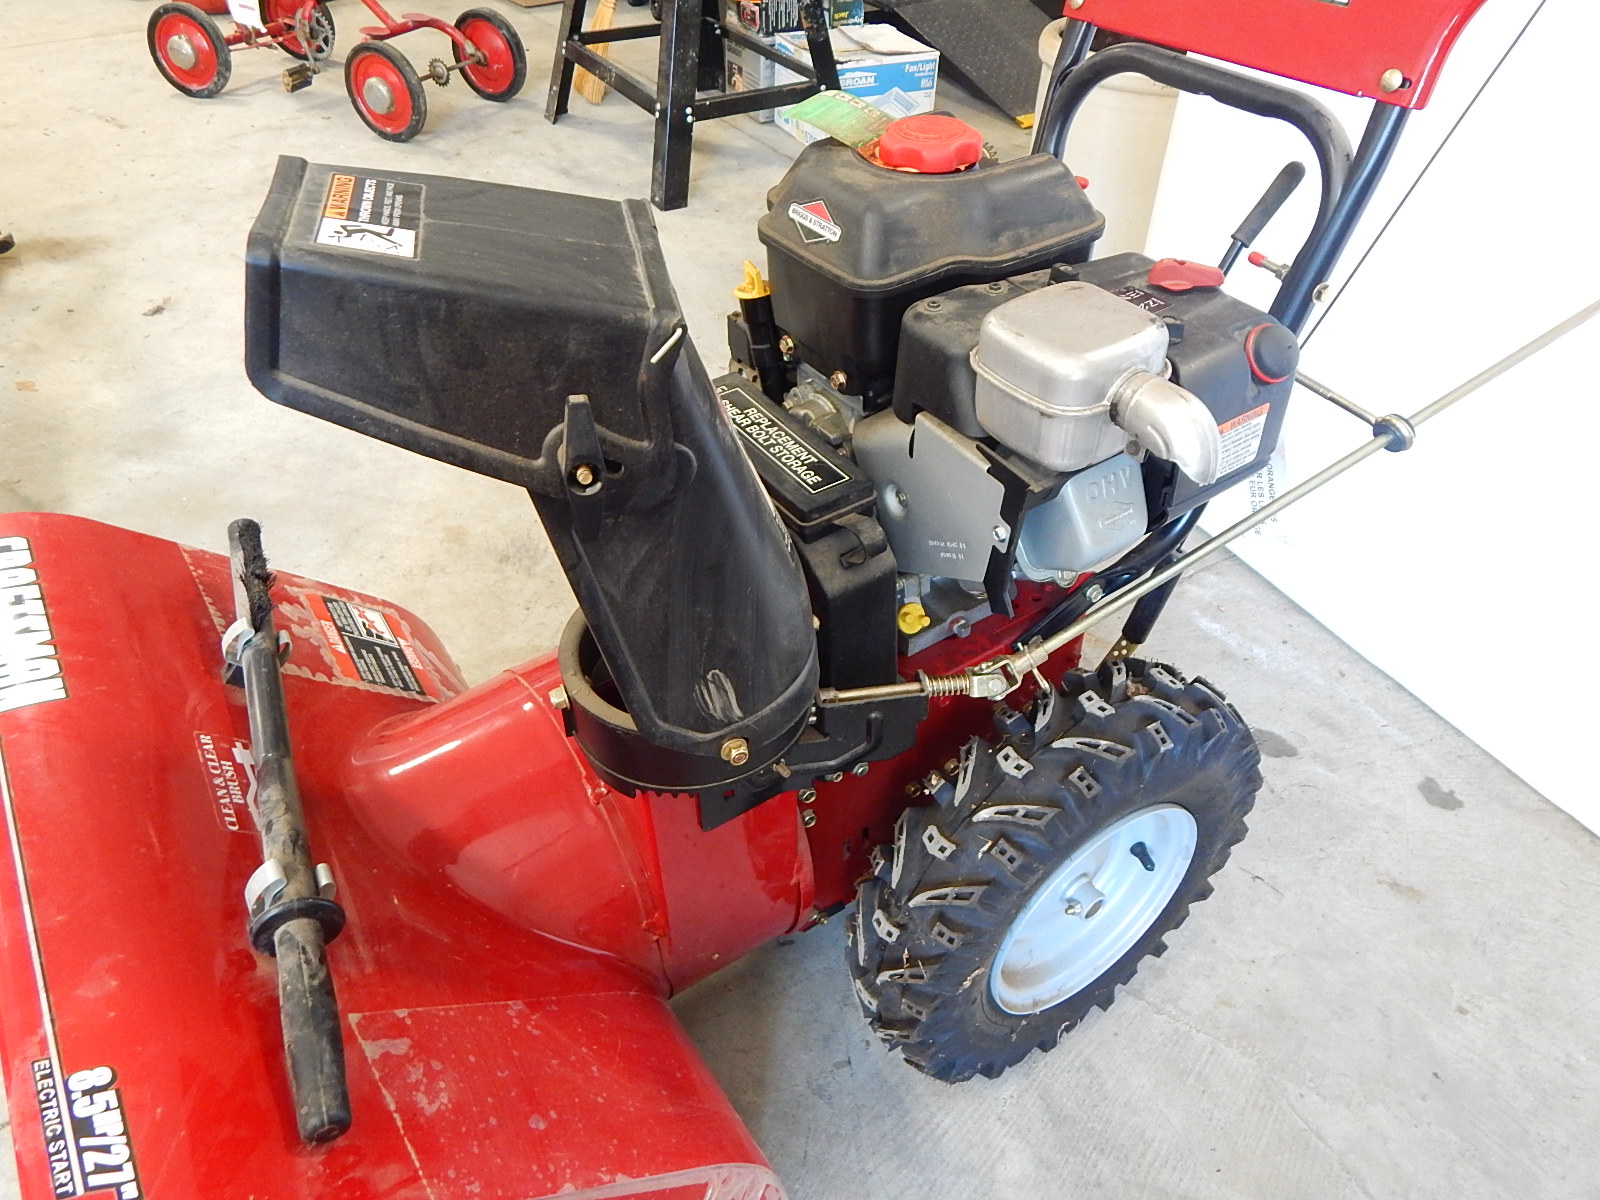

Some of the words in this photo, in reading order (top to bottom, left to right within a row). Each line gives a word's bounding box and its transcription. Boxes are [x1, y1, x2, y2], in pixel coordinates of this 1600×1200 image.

[840, 75, 876, 87] BROAN
[904, 60, 936, 74] Fan/Light
[328, 177, 353, 210] WARNING
[362, 178, 378, 201] OBJECTS
[791, 207, 809, 222] BRIGGS
[813, 219, 838, 238] STRATTON
[1230, 406, 1264, 430] WARNING
[721, 399, 752, 427] SHEAR
[746, 424, 777, 447] BOLT
[769, 442, 823, 485] STORAGE
[743, 407, 819, 464] REPLACEMENT
[200, 734, 222, 774] CLEAR
[213, 777, 226, 787] &
[220, 760, 245, 804] BRUSH
[216, 787, 240, 831] CLEAN
[33, 1059, 63, 1138] ELECTRIC
[48, 1139, 75, 1195] START
